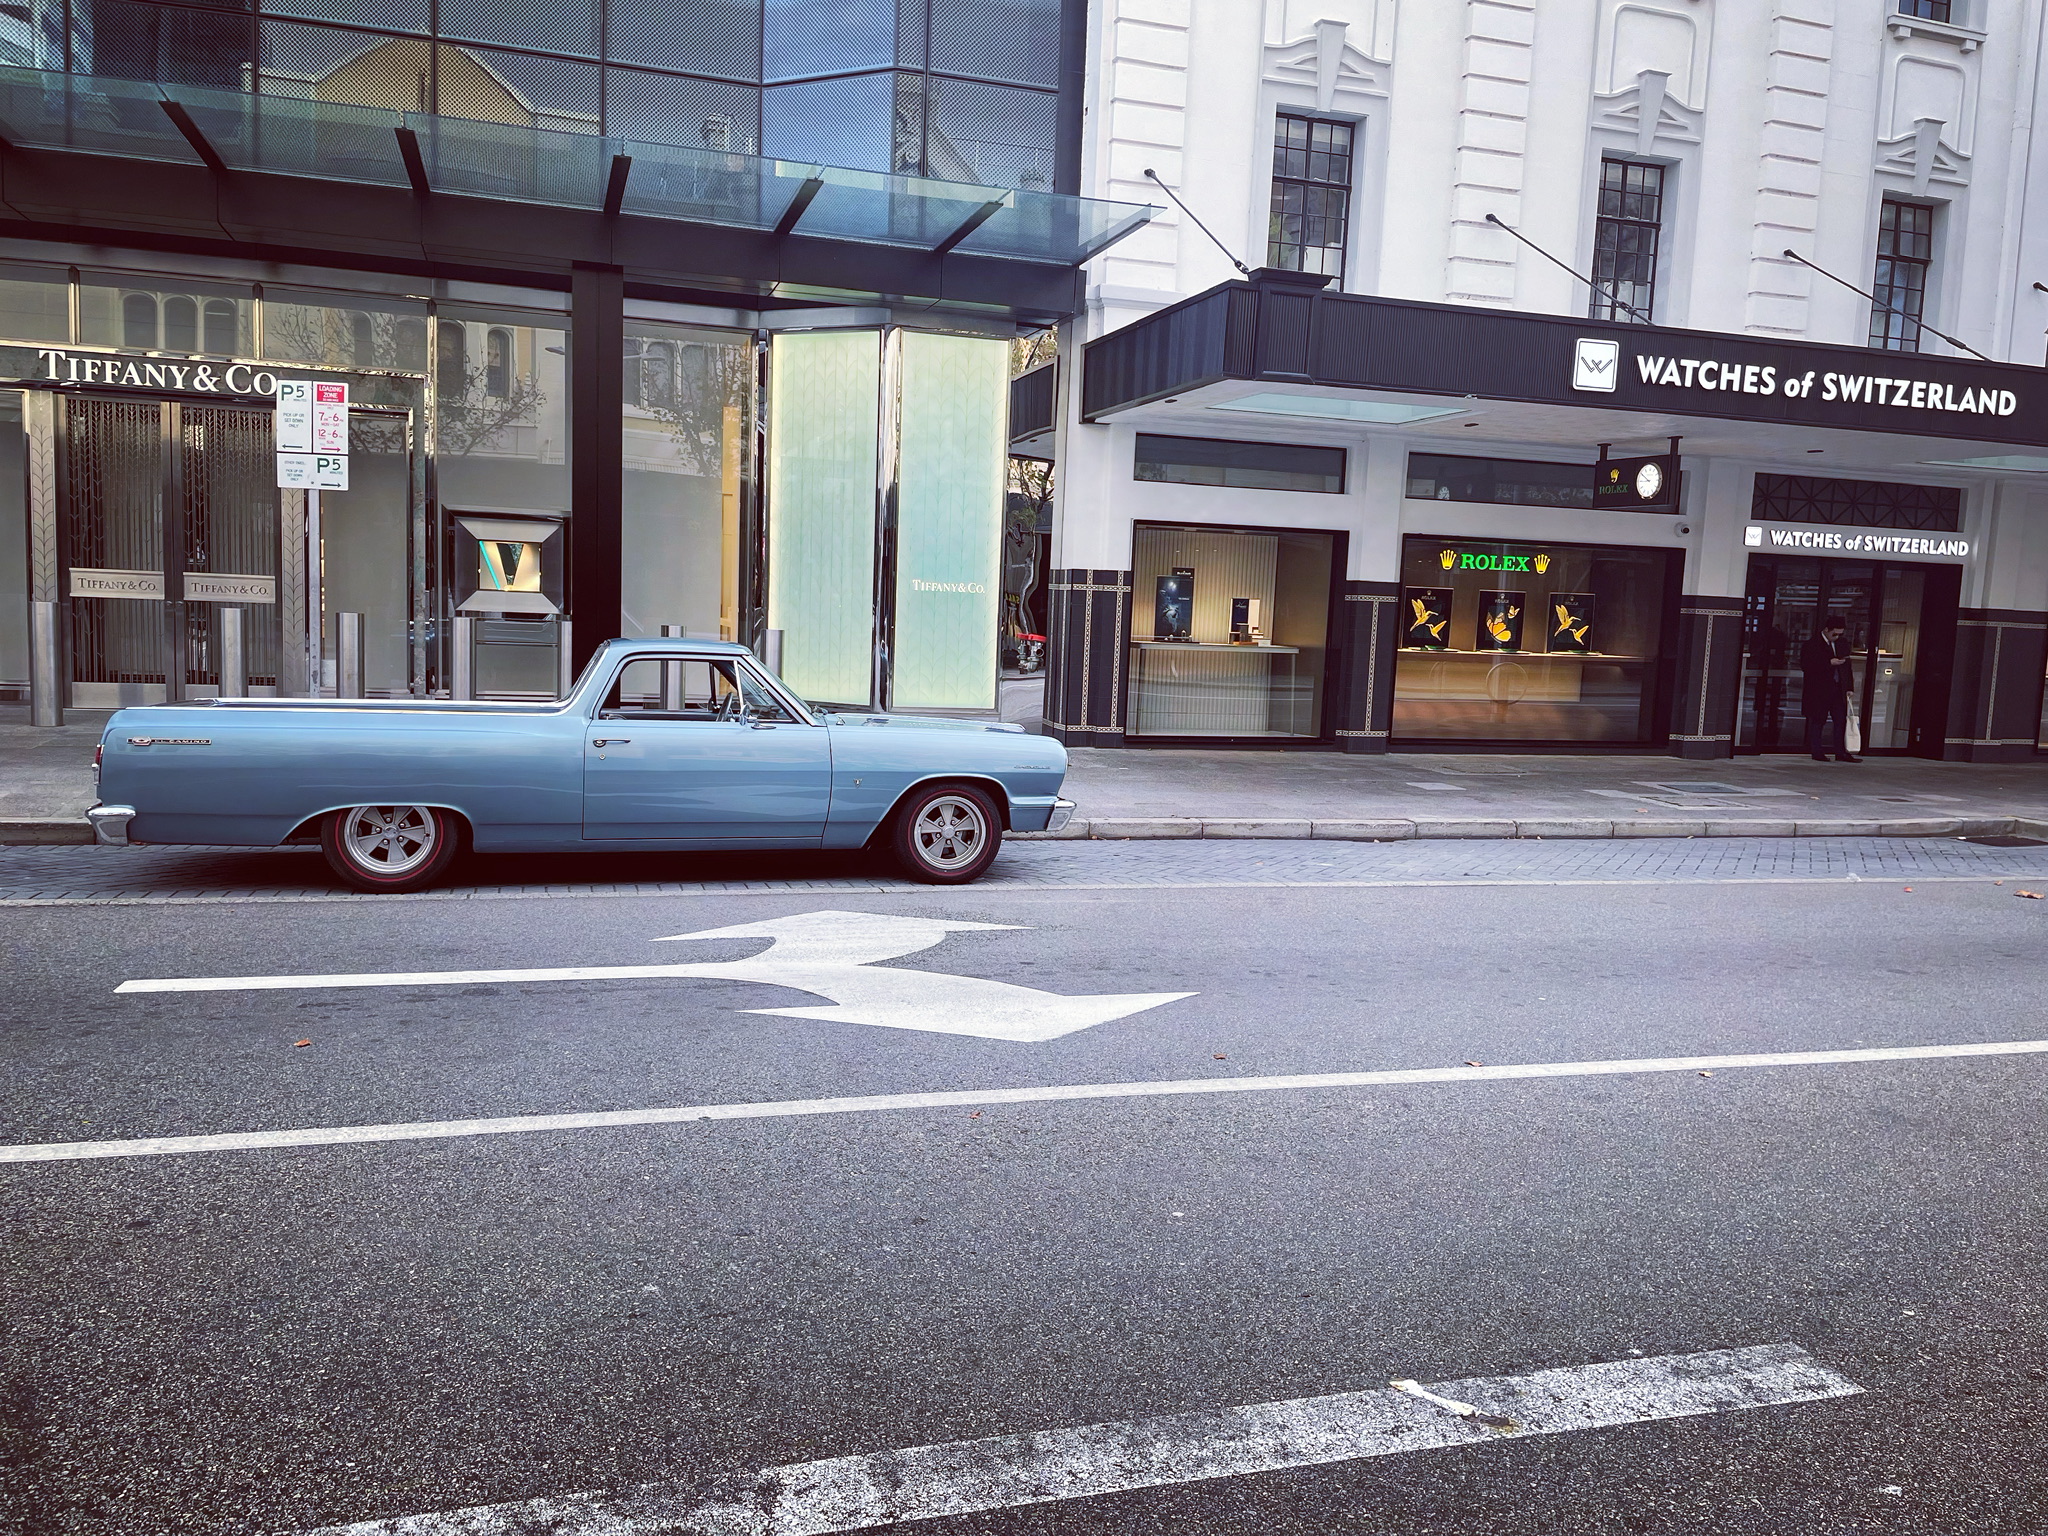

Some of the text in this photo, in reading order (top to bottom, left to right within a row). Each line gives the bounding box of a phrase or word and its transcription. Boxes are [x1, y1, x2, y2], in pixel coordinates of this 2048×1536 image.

[38, 350, 190, 390] TIFFANY
[1636, 354, 2017, 417] WATCHES of SWITZERLAND
[1599, 484, 1628, 495] ROLEX
[1769, 529, 1969, 557] WATCHES of SWITZERLAND
[1460, 553, 1530, 572] ROLEX
[77, 577, 127, 590] TIFFANY
[191, 582, 239, 594] TIFFANY
[912, 579, 958, 593] TIFFANY
